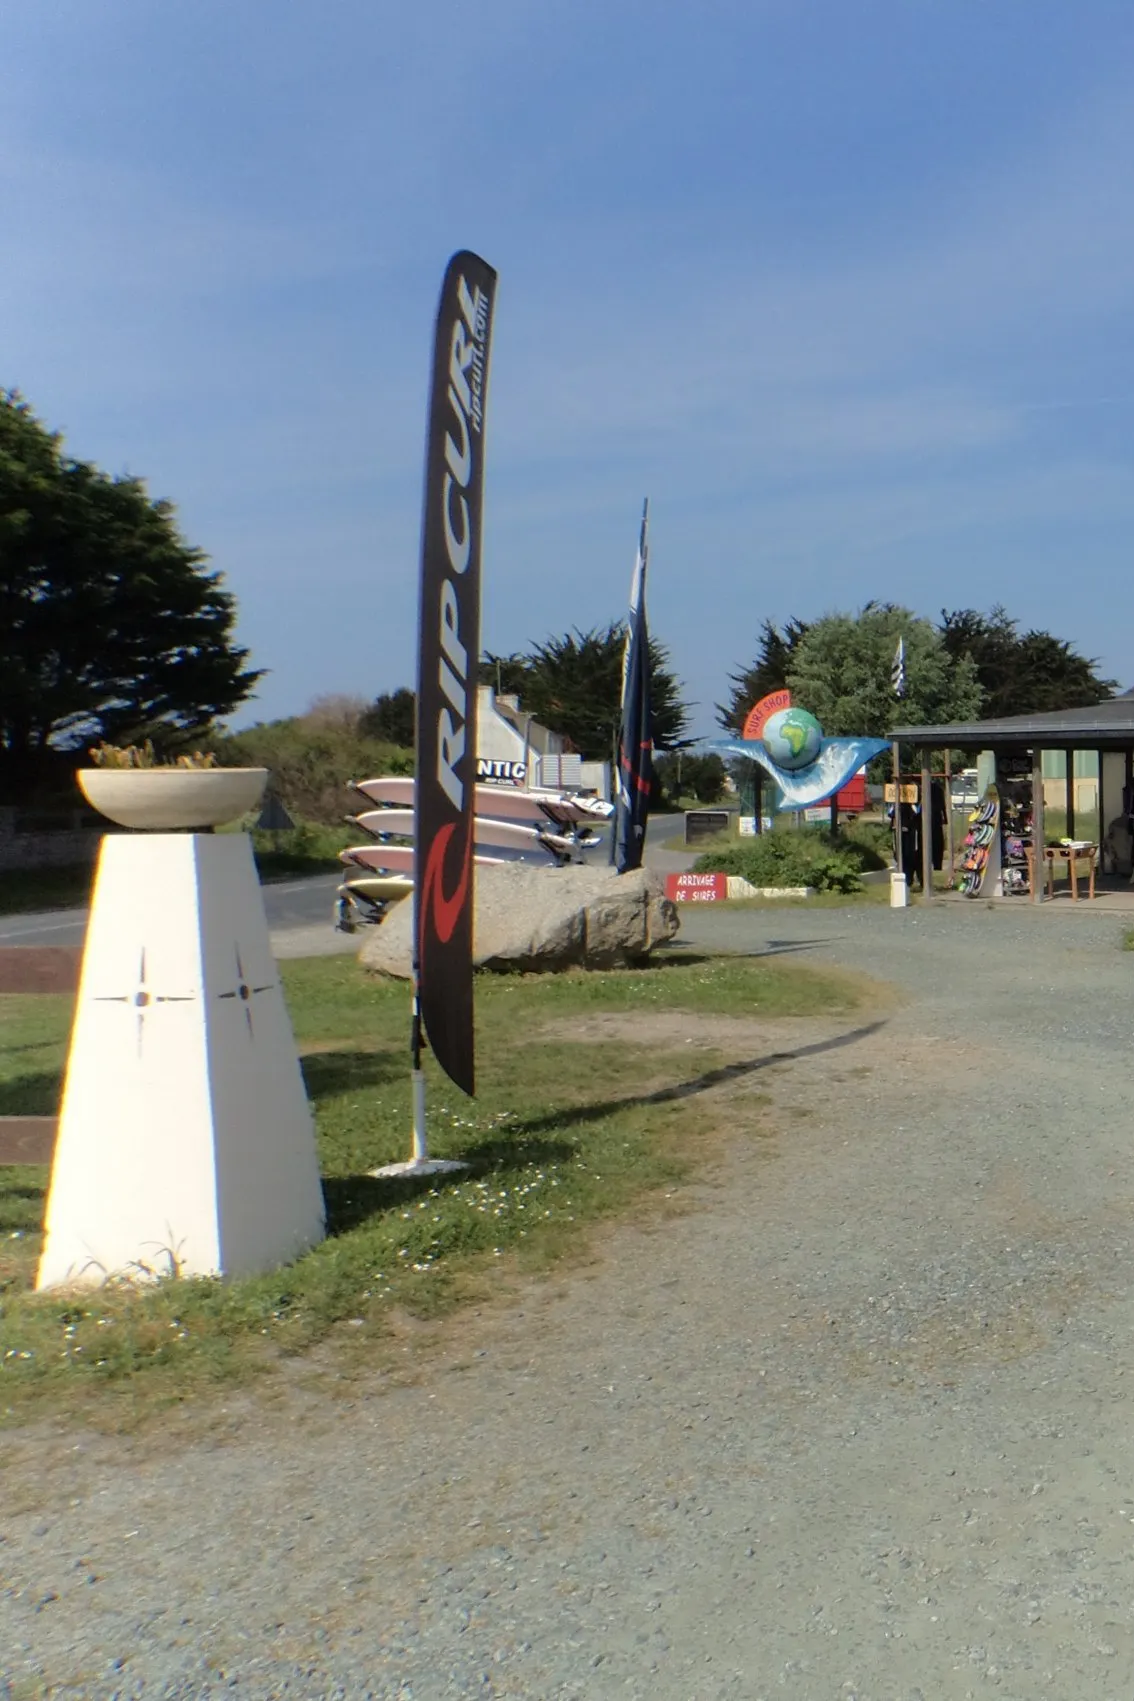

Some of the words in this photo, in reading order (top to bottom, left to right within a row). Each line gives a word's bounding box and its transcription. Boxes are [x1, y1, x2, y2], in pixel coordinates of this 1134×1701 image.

[471, 291, 488, 432] ripcurl.com
[443, 274, 479, 574] CURL
[437, 578, 467, 812] RIP
[747, 708, 764, 734] SURF
[763, 694, 788, 711] SHOP
[477, 760, 526, 778] NTIC
[676, 890, 687, 902] DE
[692, 890, 717, 902] SURFS
[677, 874, 716, 886] ARRIVAGE
